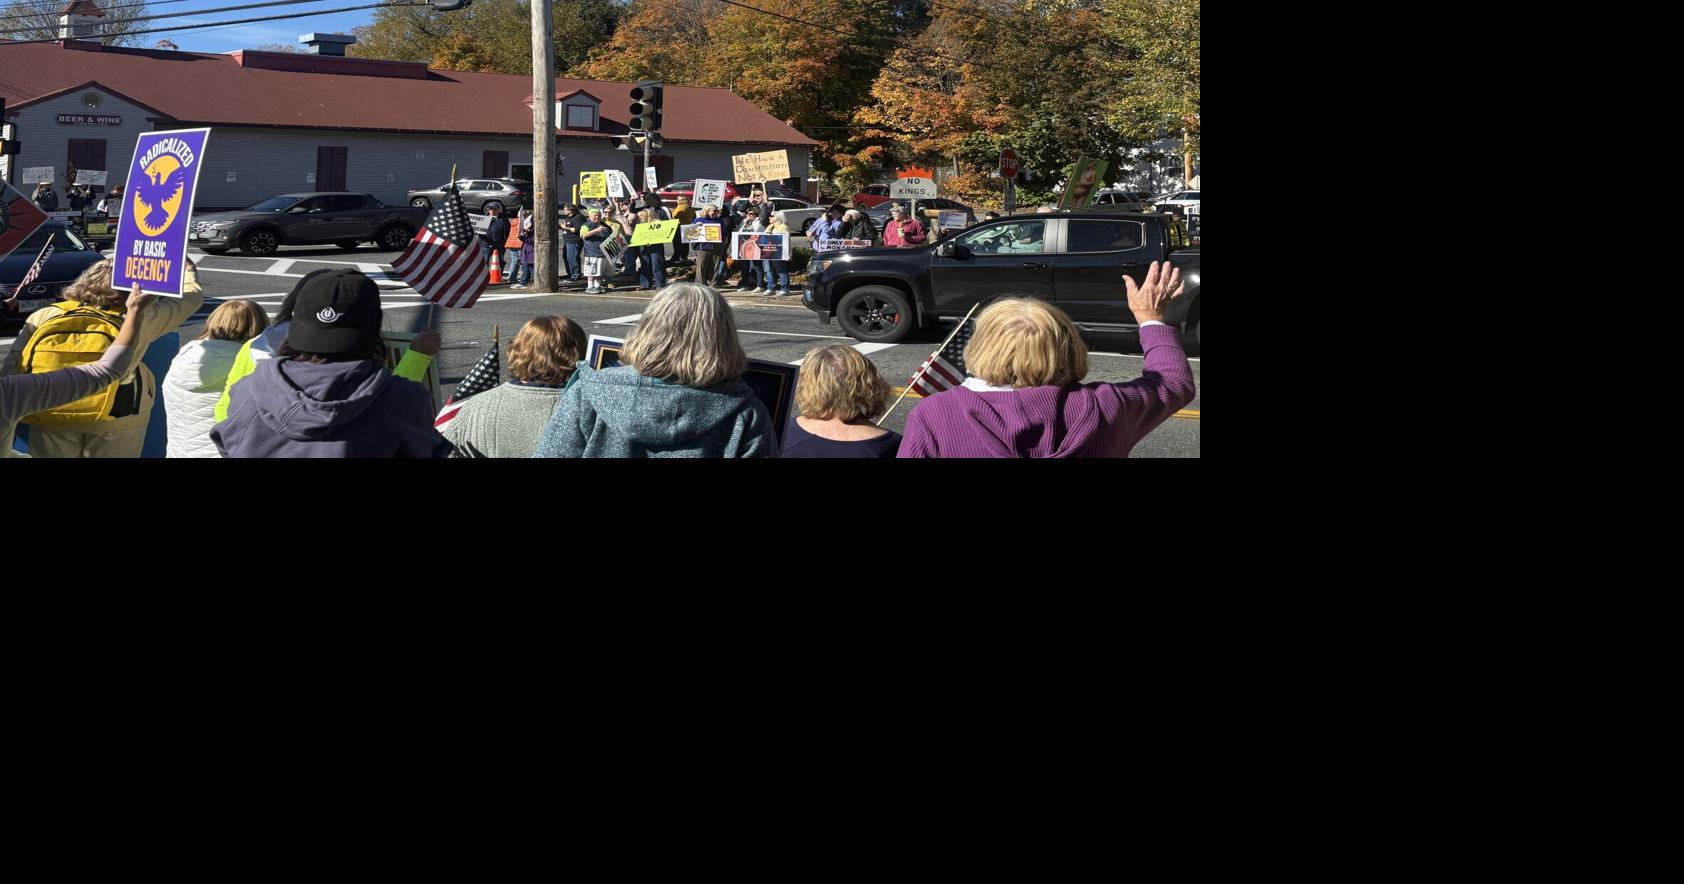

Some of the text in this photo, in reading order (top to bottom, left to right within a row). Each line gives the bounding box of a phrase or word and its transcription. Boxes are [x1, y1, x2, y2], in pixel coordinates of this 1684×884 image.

[96, 116, 121, 124] WINE
[139, 137, 194, 170] RADICALIZED
[1001, 157, 1018, 169] STOP
[648, 223, 662, 231] NO
[133, 239, 167, 258] BY BASIC
[125, 256, 171, 282] DECENCY
